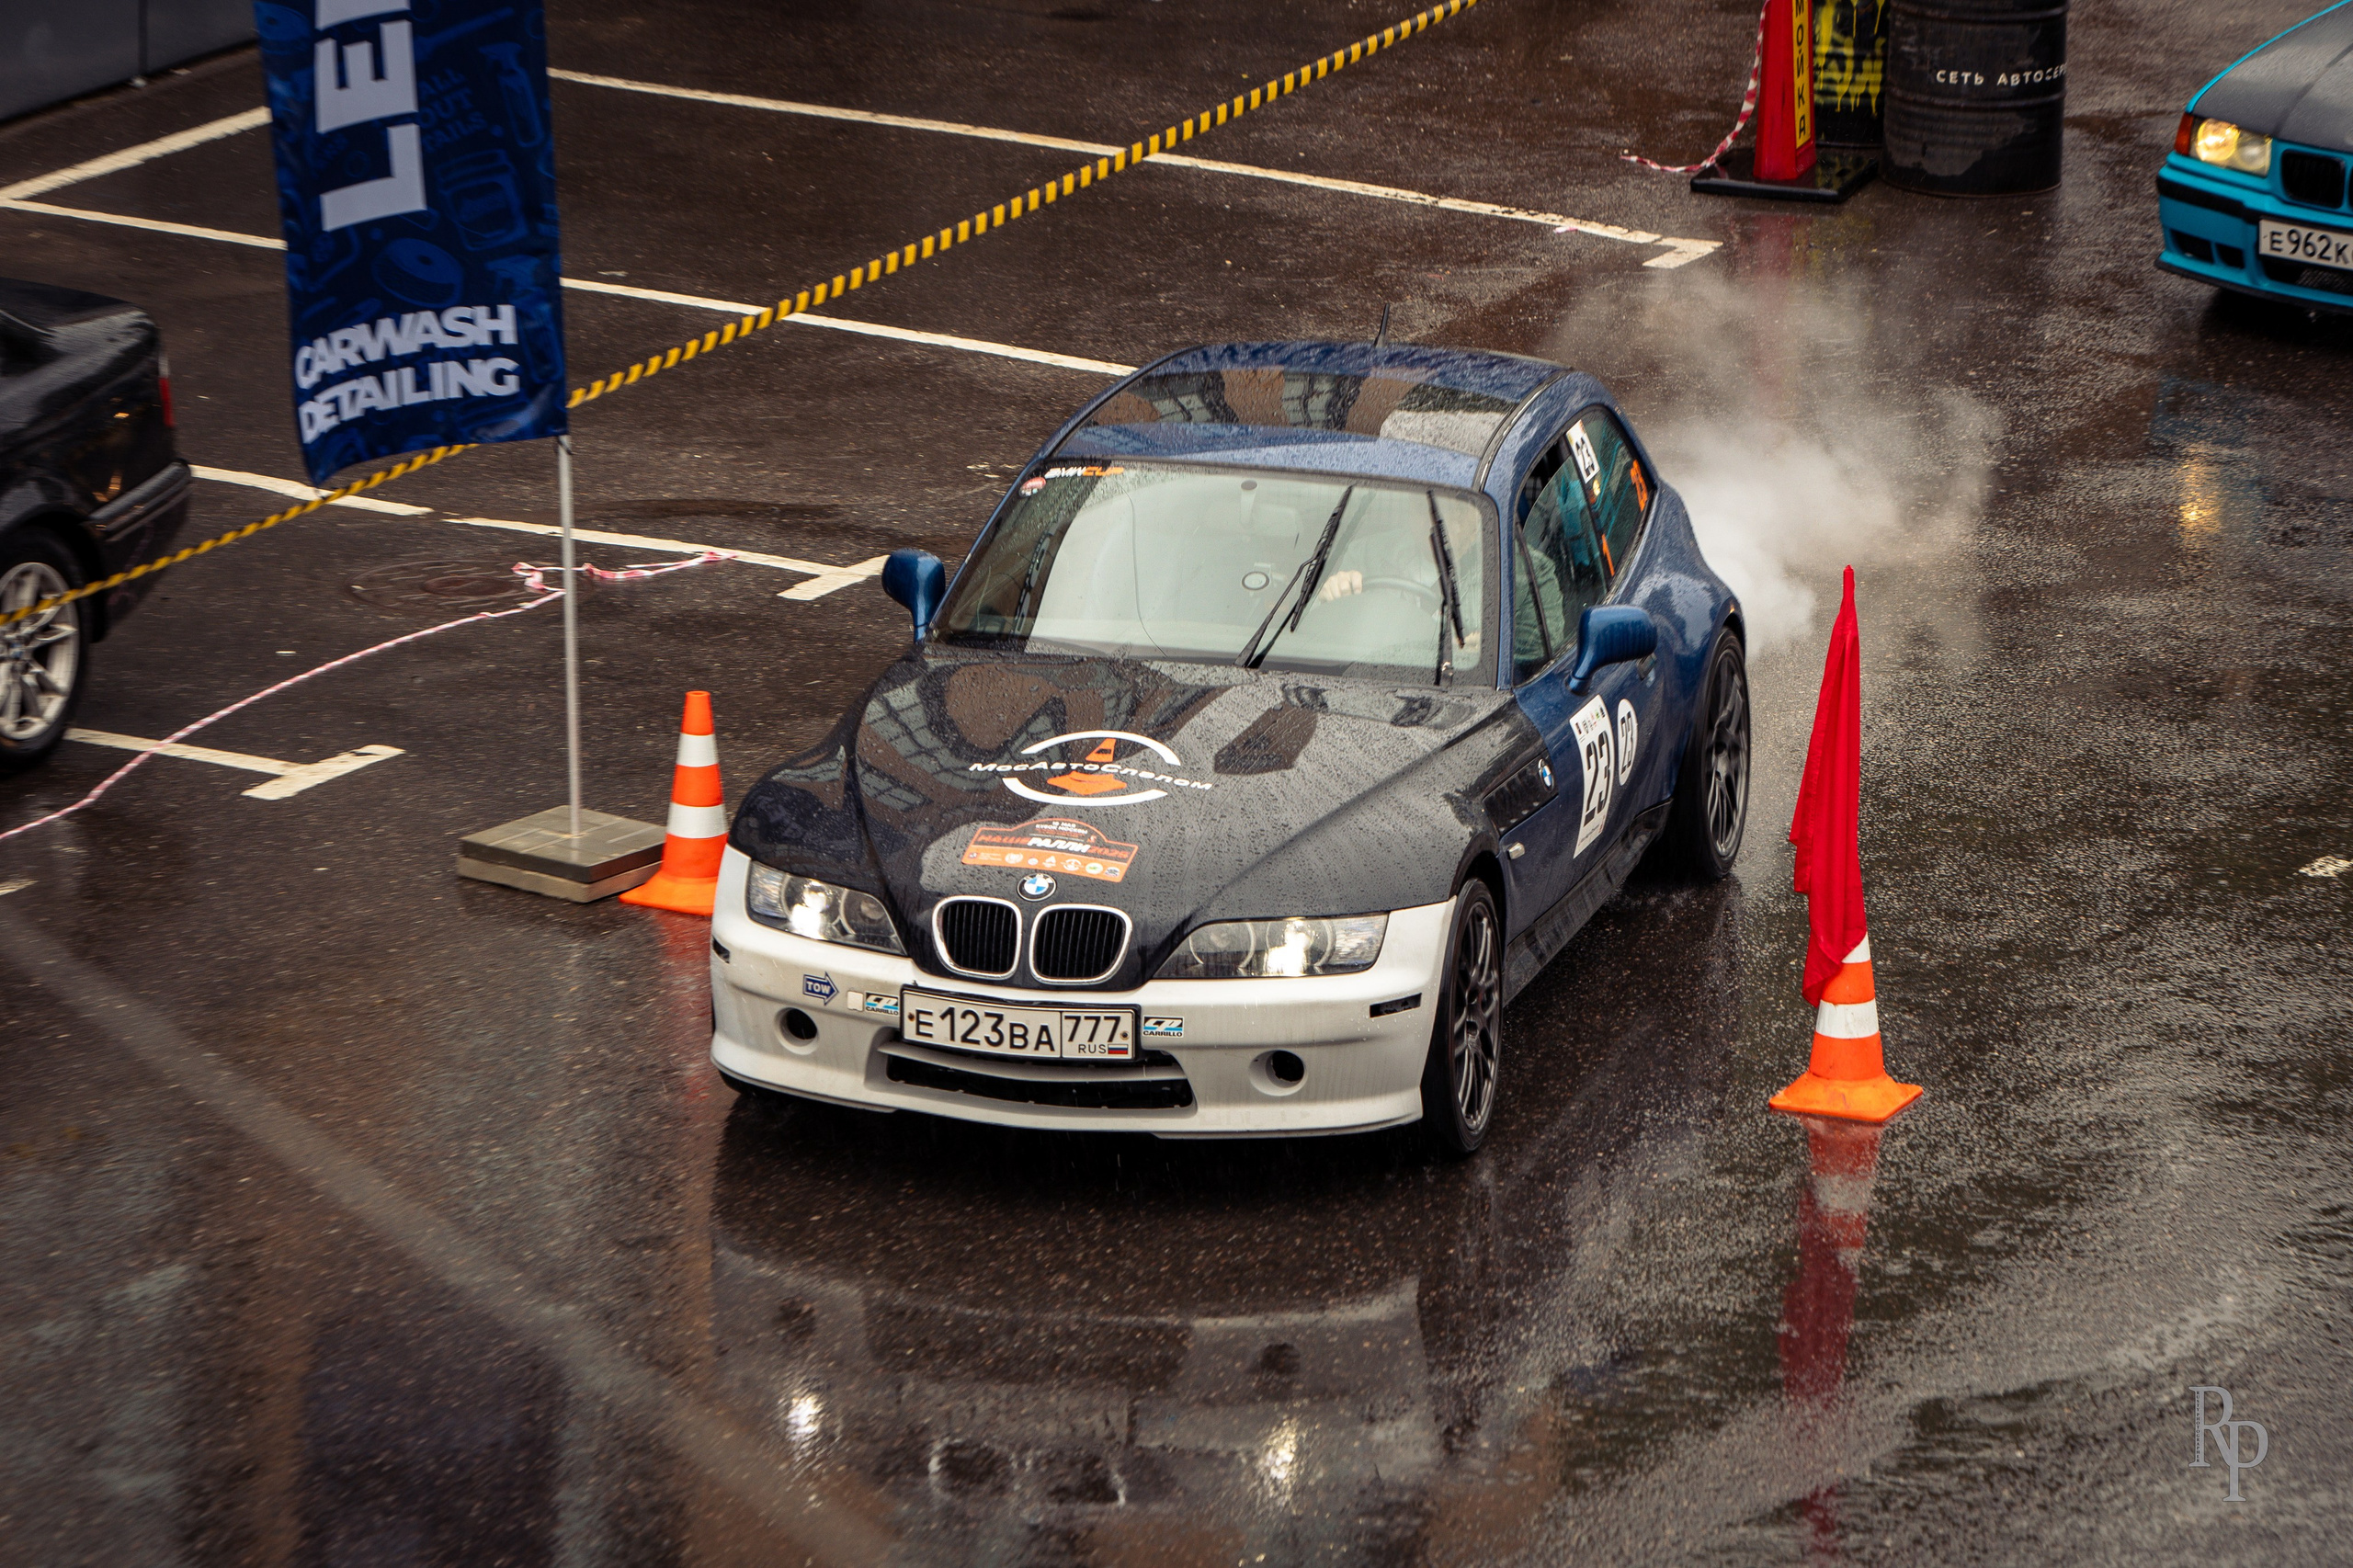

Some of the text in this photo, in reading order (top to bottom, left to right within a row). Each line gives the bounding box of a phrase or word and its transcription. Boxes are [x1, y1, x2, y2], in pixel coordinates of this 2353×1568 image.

[1936, 69, 1984, 85] СЕТЬ
[2269, 228, 2353, 265] Е962К
[295, 304, 518, 389] CARWASH
[299, 357, 520, 444] DETAILING
[1620, 710, 1633, 776] 23
[1584, 730, 1610, 827] 23
[806, 981, 831, 994] TOW
[865, 1006, 899, 1016] CARRILLO
[1064, 1016, 1121, 1042] 777
[1078, 1044, 1107, 1054] RUS
